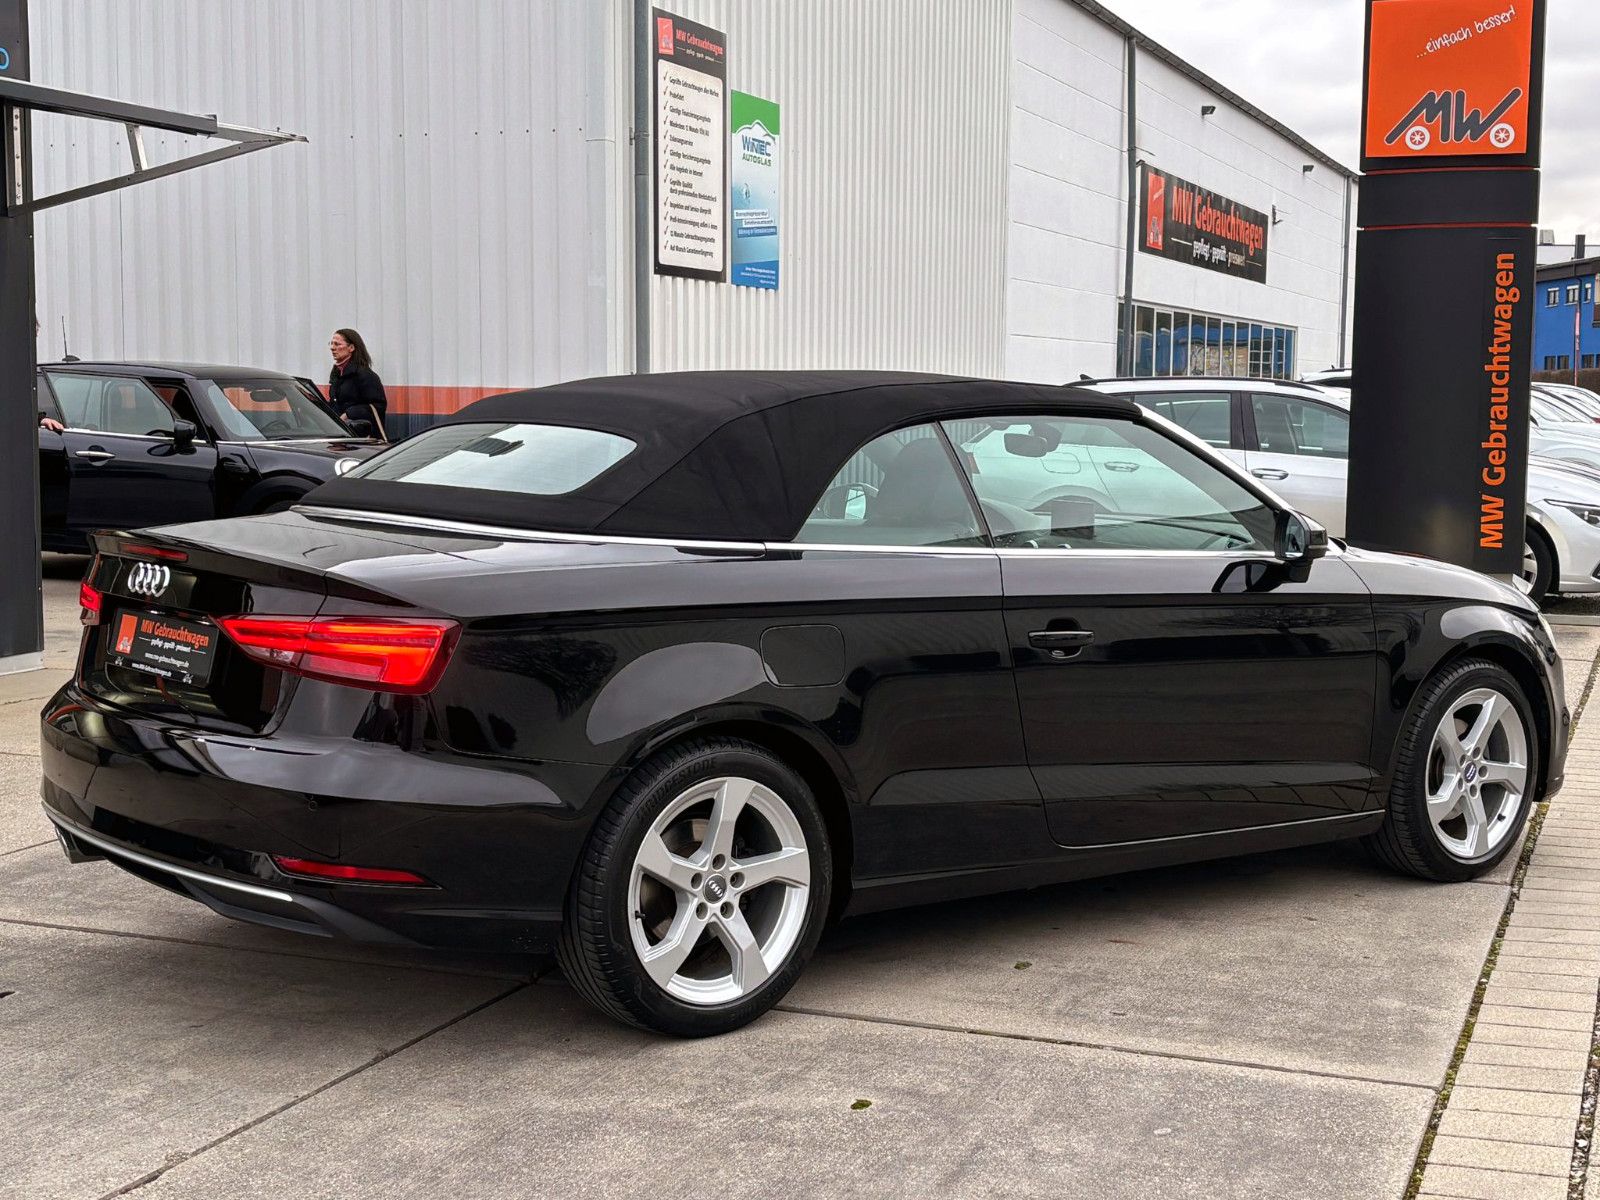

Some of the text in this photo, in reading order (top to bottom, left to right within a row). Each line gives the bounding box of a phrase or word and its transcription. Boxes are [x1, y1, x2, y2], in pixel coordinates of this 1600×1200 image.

[1475, 5, 1516, 34] besser!
[1384, 87, 1522, 145] MW
[742, 153, 772, 167] AUTOGLAS
[1172, 186, 1263, 256] MW Gebrauchtwagen
[1480, 253, 1521, 549] MW Gebrauchtwagen
[141, 619, 209, 649] MW Gebrauchtwagen
